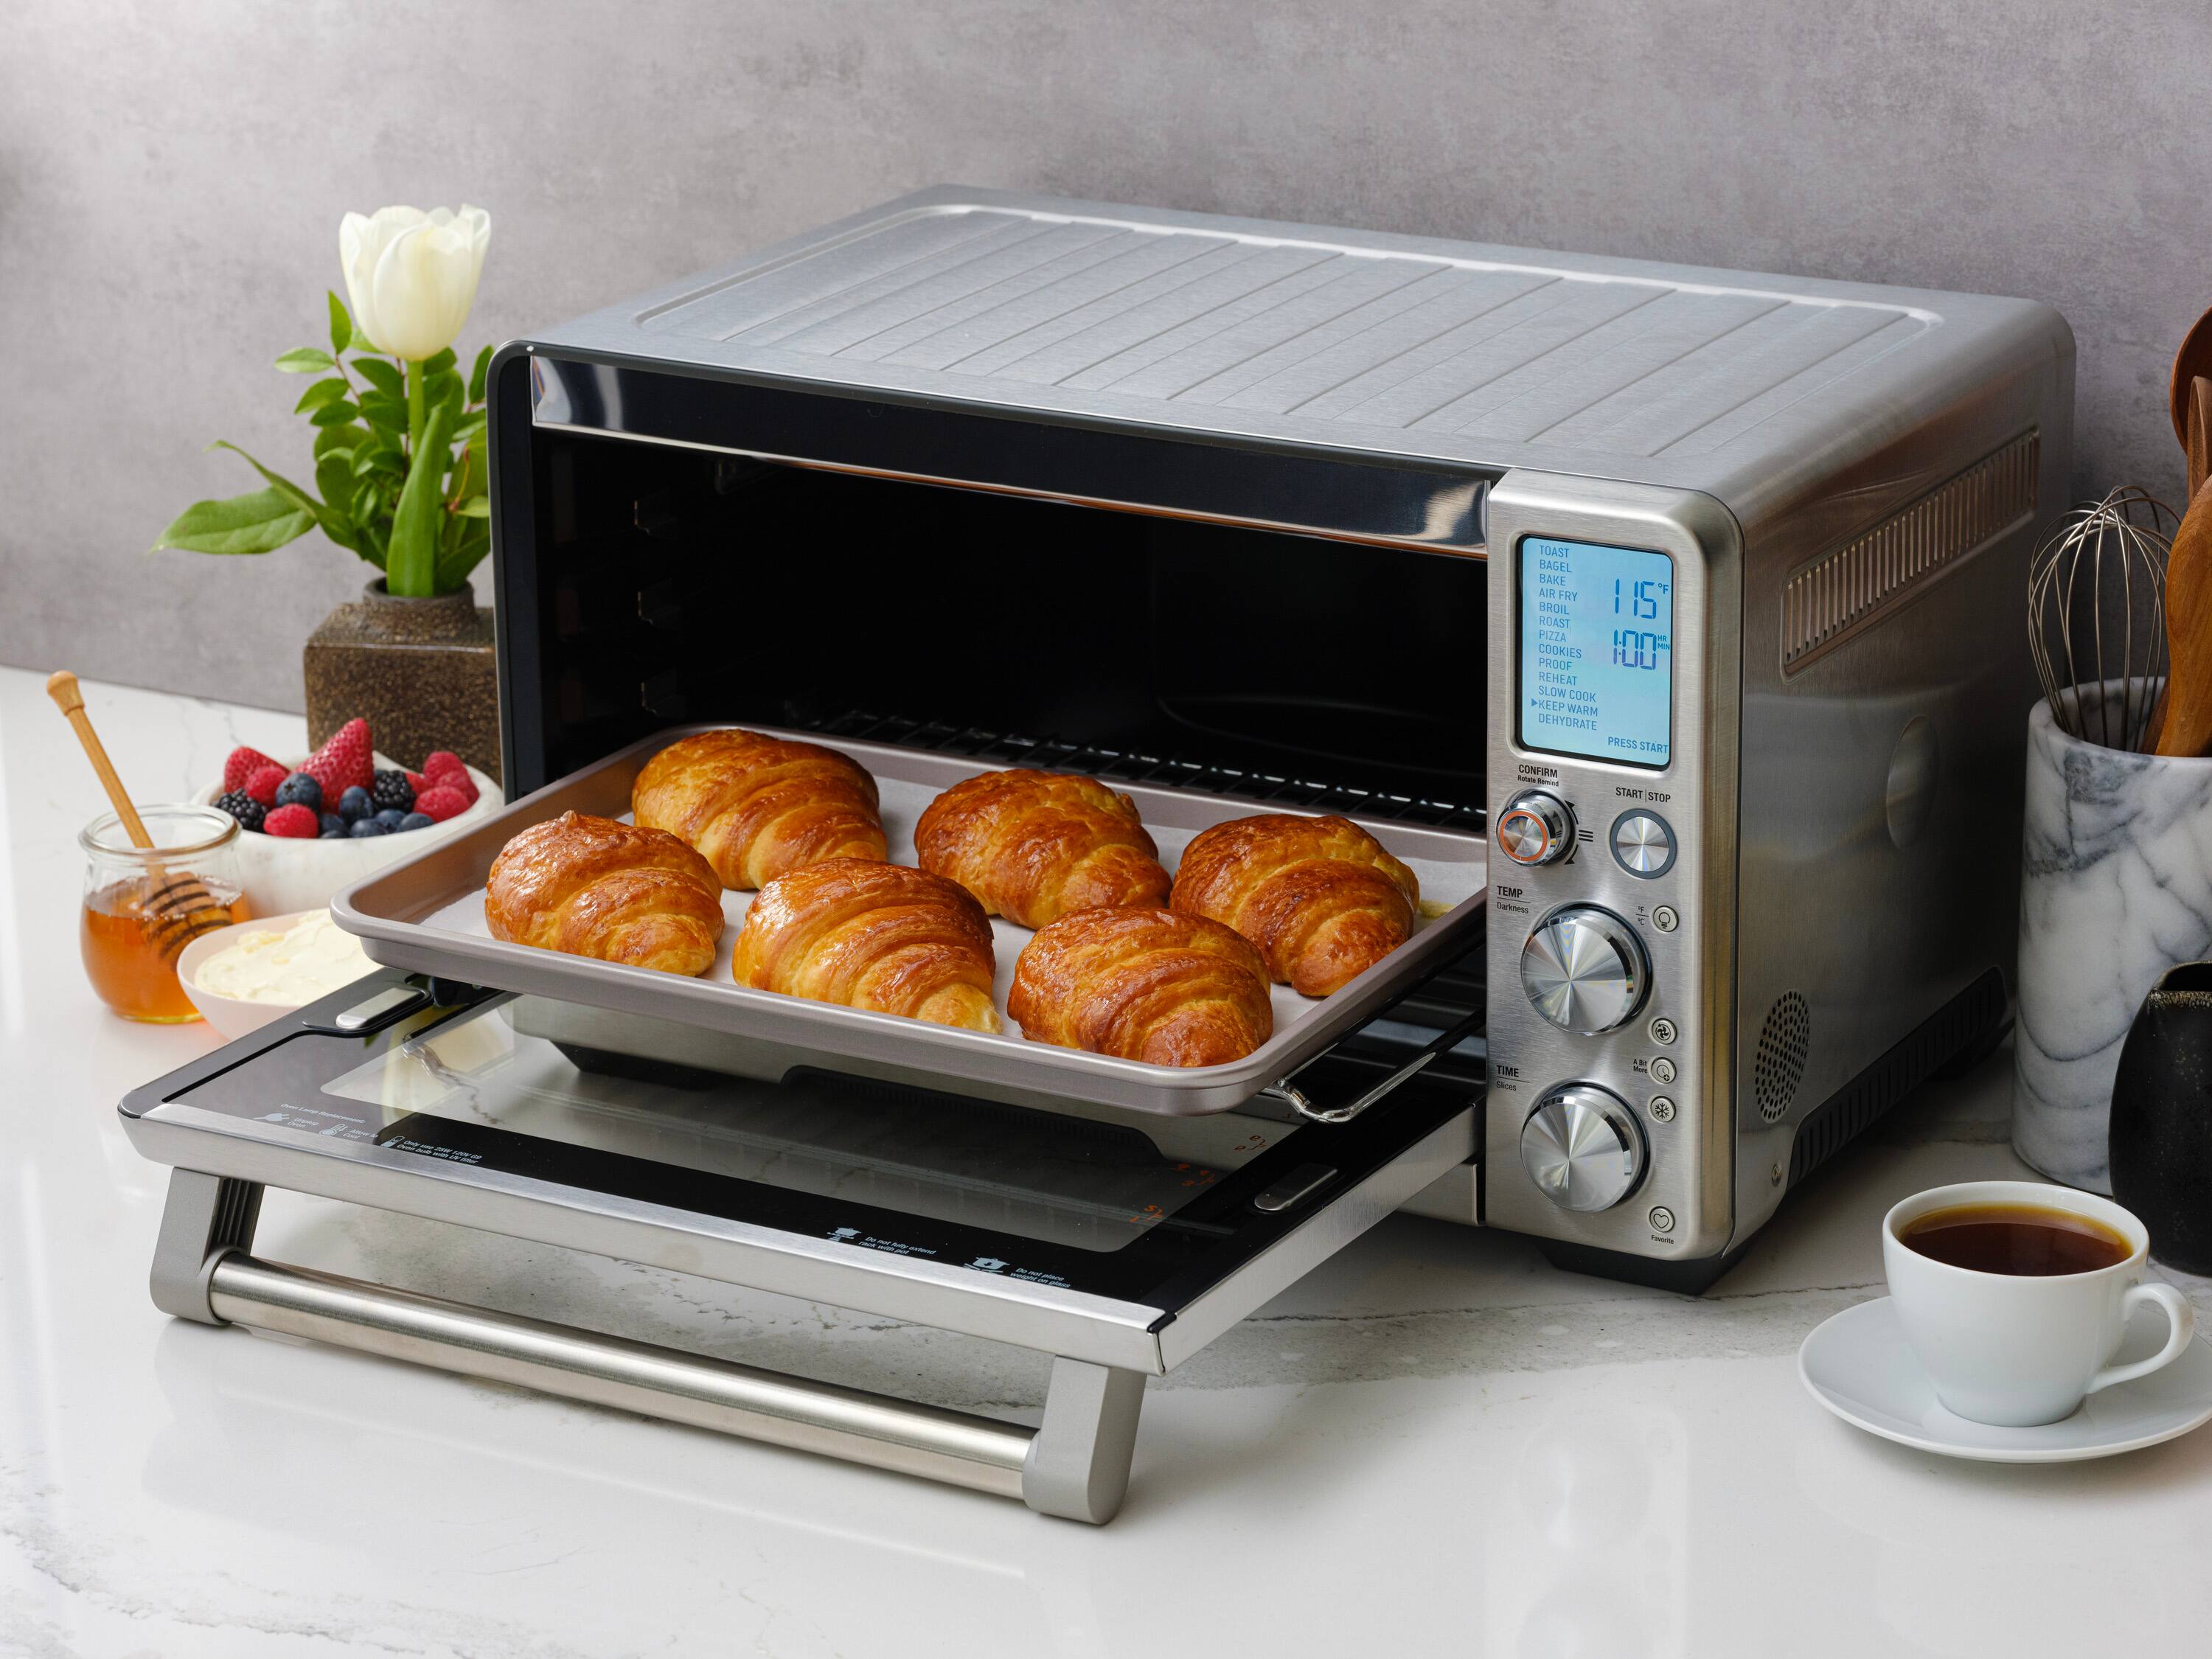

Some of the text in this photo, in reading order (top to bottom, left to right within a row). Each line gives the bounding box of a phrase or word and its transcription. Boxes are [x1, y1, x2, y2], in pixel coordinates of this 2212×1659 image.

[1539, 544, 1570, 558] TOAST
[1539, 559, 1572, 573] BAGEL
[1539, 573, 1566, 586] BAKE
[1539, 588, 1578, 602] AIR FRY
[1615, 578, 1657, 619] 115
[1539, 602, 1570, 615] BROIL
[1539, 616, 1571, 629] ROAST
[1539, 630, 1567, 642] PIZZA
[1539, 644, 1582, 658] COOKIES
[1658, 642, 1670, 650] MIN
[1539, 657, 1572, 671] PROOF
[1539, 672, 1578, 686] REHEAT
[1538, 686, 1596, 702] SLOW COOK
[1539, 700, 1598, 717] KEEP WARM
[1539, 713, 1597, 731] DEHYDRATE
[1607, 737, 1669, 754] PRESS START
[1518, 764, 1558, 779] CONFIRM
[1517, 775, 1559, 787] Rotate Remind
[1497, 886, 1523, 898] TEMP
[1497, 901, 1529, 914] Darkness
[1497, 1065, 1519, 1078] TIME
[1633, 1066, 1648, 1074] More
[1496, 1081, 1517, 1091] Slices
[1651, 1234, 1674, 1245] Favorite
[908, 1246, 937, 1254] extend
[1010, 1273, 1037, 1281] weight
